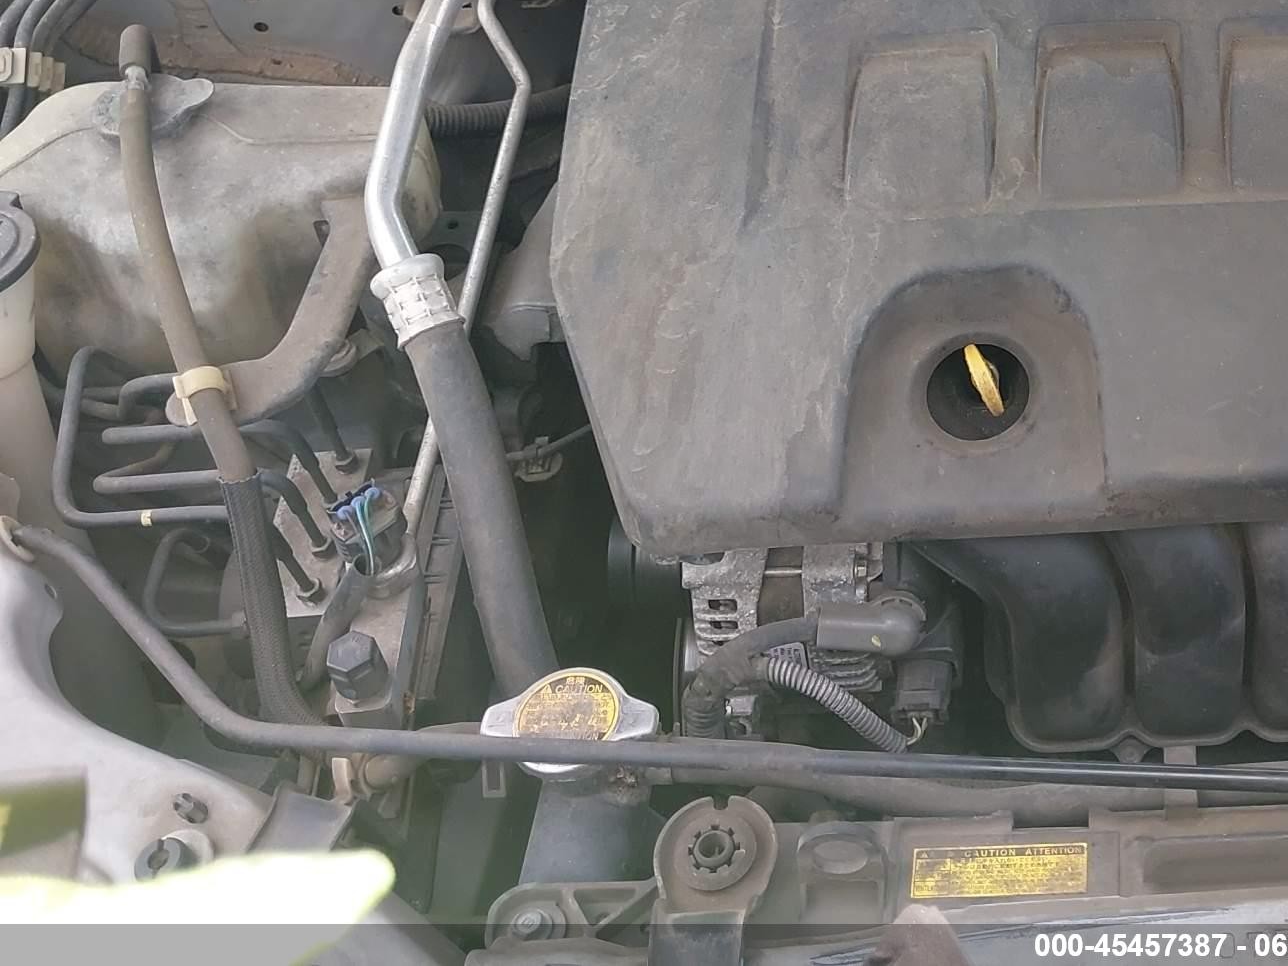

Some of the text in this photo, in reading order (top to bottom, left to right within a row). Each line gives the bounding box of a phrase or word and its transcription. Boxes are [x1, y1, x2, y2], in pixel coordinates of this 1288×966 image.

[555, 684, 603, 694] CAUTION
[964, 846, 1082, 858] CAUTION ATTENTION
